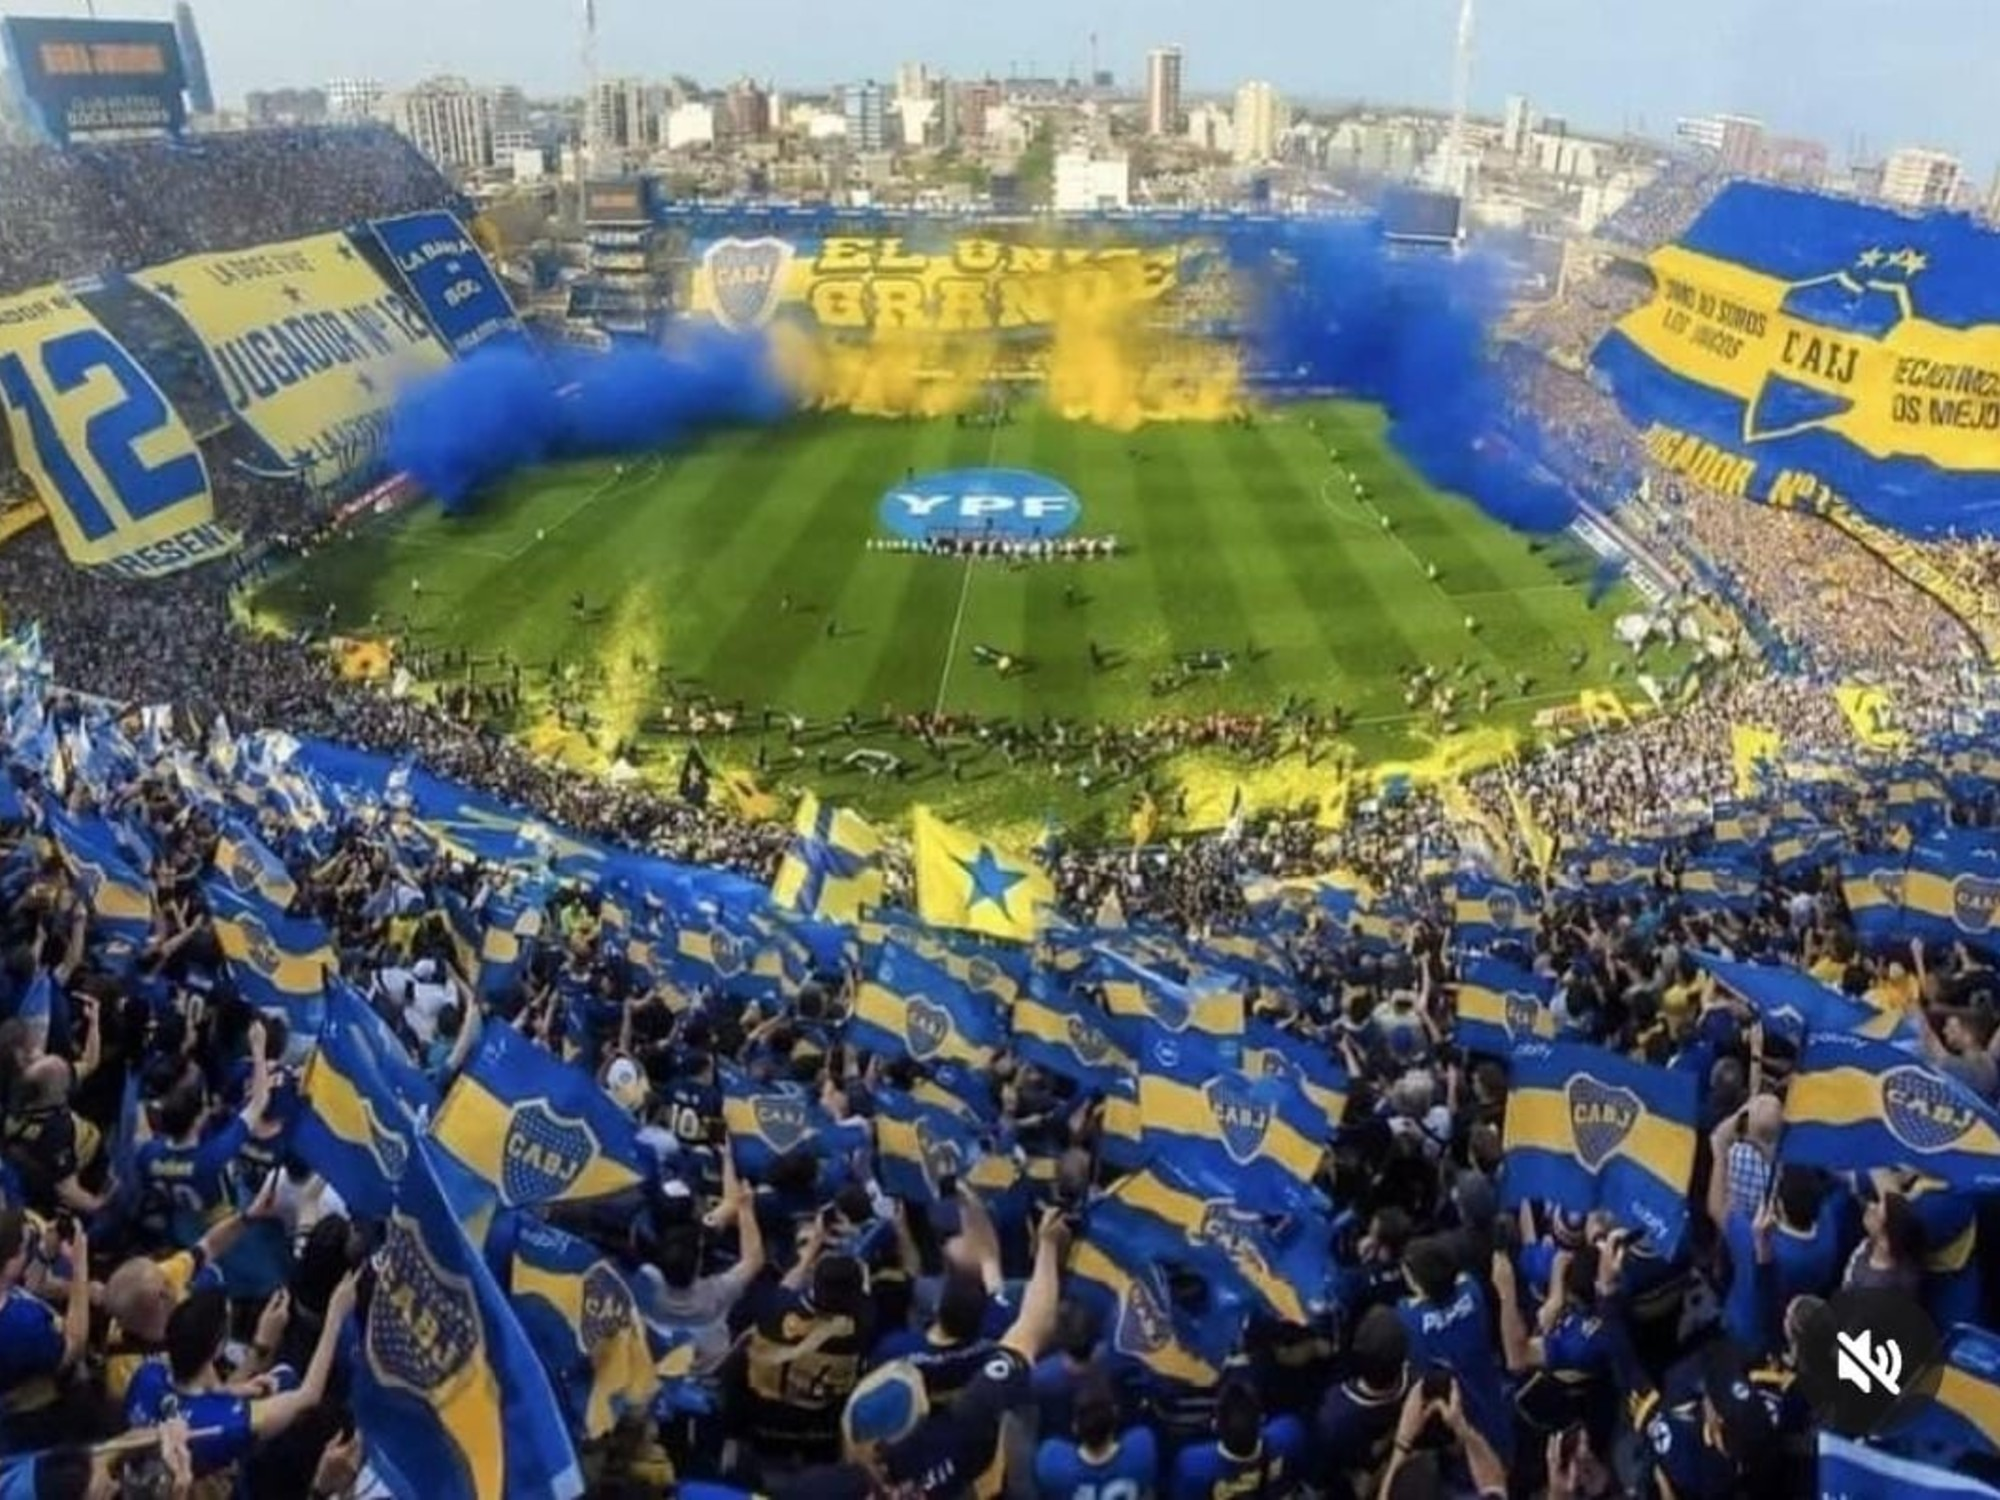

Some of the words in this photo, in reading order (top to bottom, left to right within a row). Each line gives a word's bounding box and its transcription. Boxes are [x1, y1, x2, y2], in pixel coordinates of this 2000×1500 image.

[816, 237, 927, 272] EL
[213, 312, 372, 409] JUGADOR
[384, 293, 429, 344] 12
[1, 328, 208, 543] 12
[895, 494, 1071, 518] YPF
[672, 1102, 700, 1139] 10
[1573, 1103, 1631, 1127] CABJ
[1888, 1088, 1974, 1128] CABJ
[507, 1131, 579, 1181] CABJ
